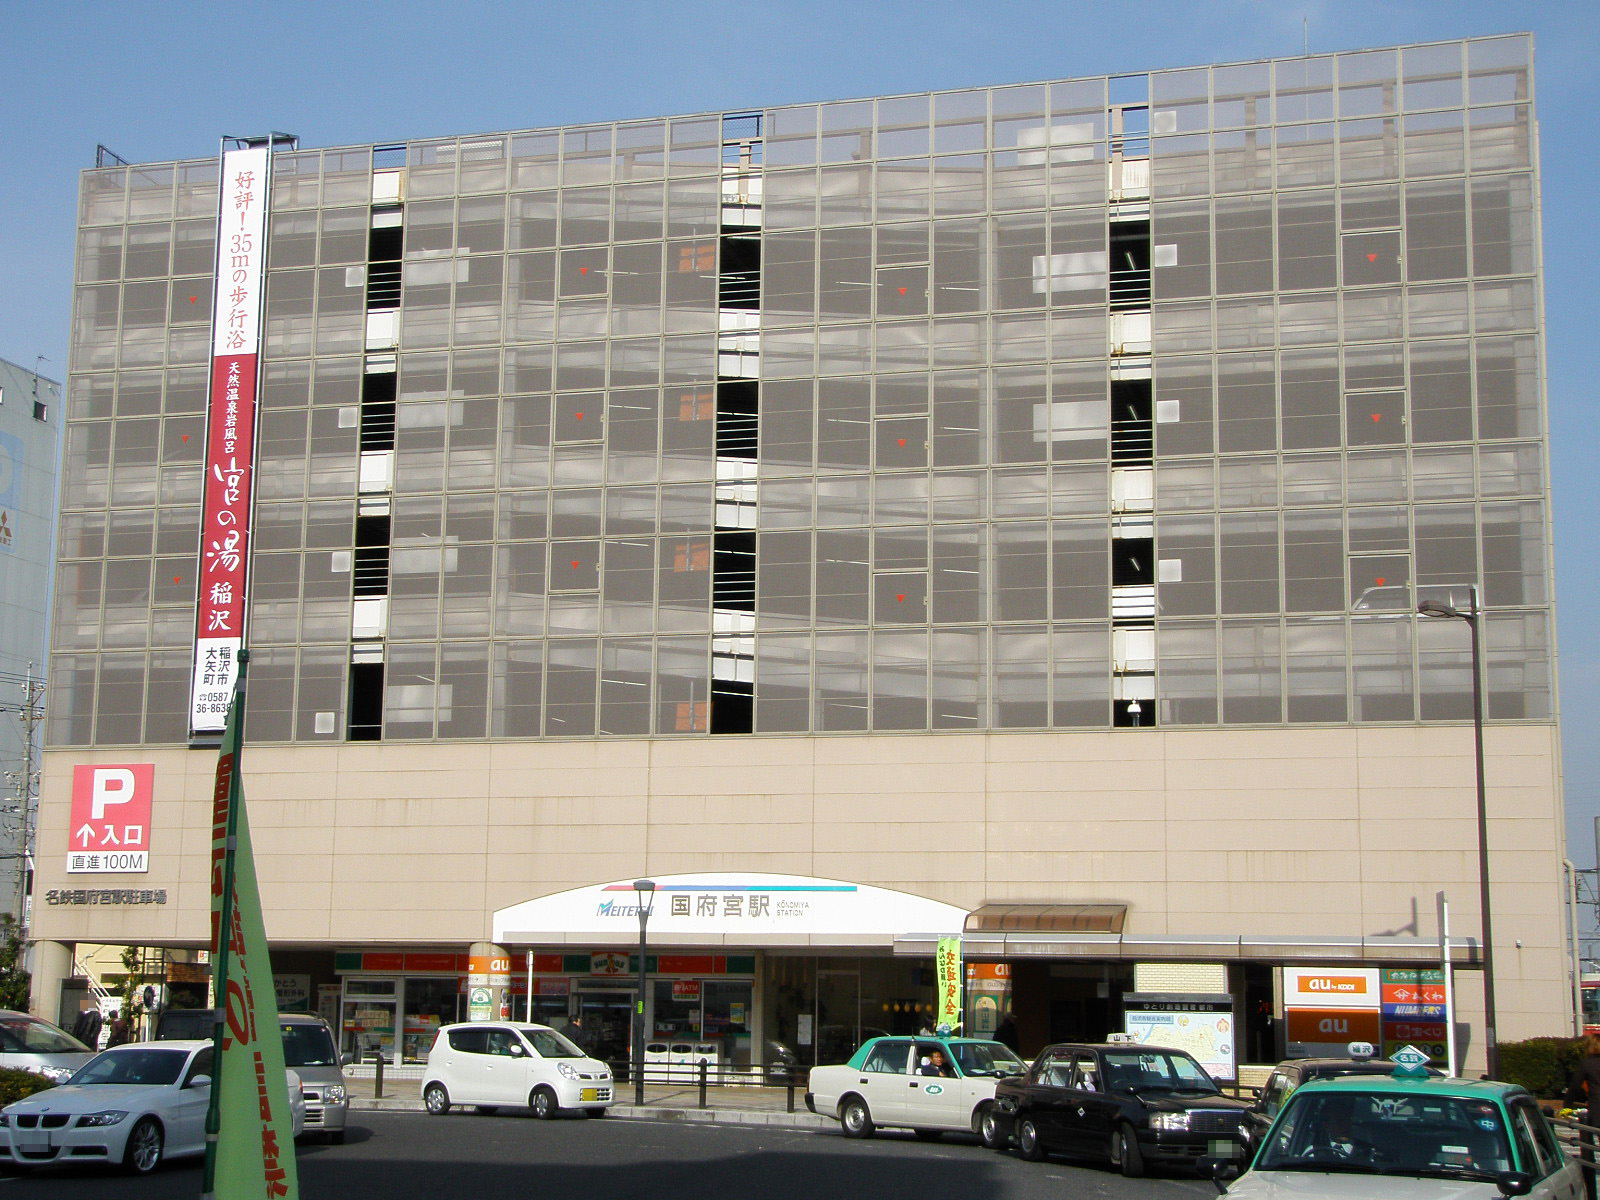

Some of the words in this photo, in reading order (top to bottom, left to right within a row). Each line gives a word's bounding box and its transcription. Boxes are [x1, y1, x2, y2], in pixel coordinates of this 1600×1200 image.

[226, 170, 255, 350] 好評！35mの歩行浴
[224, 361, 241, 454] 天然温泉岩風呂
[207, 456, 245, 573] 宮の湯
[208, 582, 233, 631] 稲沢
[203, 647, 217, 686] 大矢町
[217, 646, 231, 686] 稲沢市
[208, 692, 228, 702] 0587
[91, 768, 135, 820] P
[101, 824, 143, 845] 入口
[45, 889, 167, 905] 名鉄国府宮駅駐車場
[671, 894, 770, 917] 国府宮駅
[490, 959, 509, 971] au
[946, 949, 957, 1016] 交通安全
[1309, 978, 1331, 990] au
[1395, 1004, 1442, 1016] NUMBERS
[1318, 1018, 1348, 1033] au
[1113, 1034, 1132, 1042] 山下
